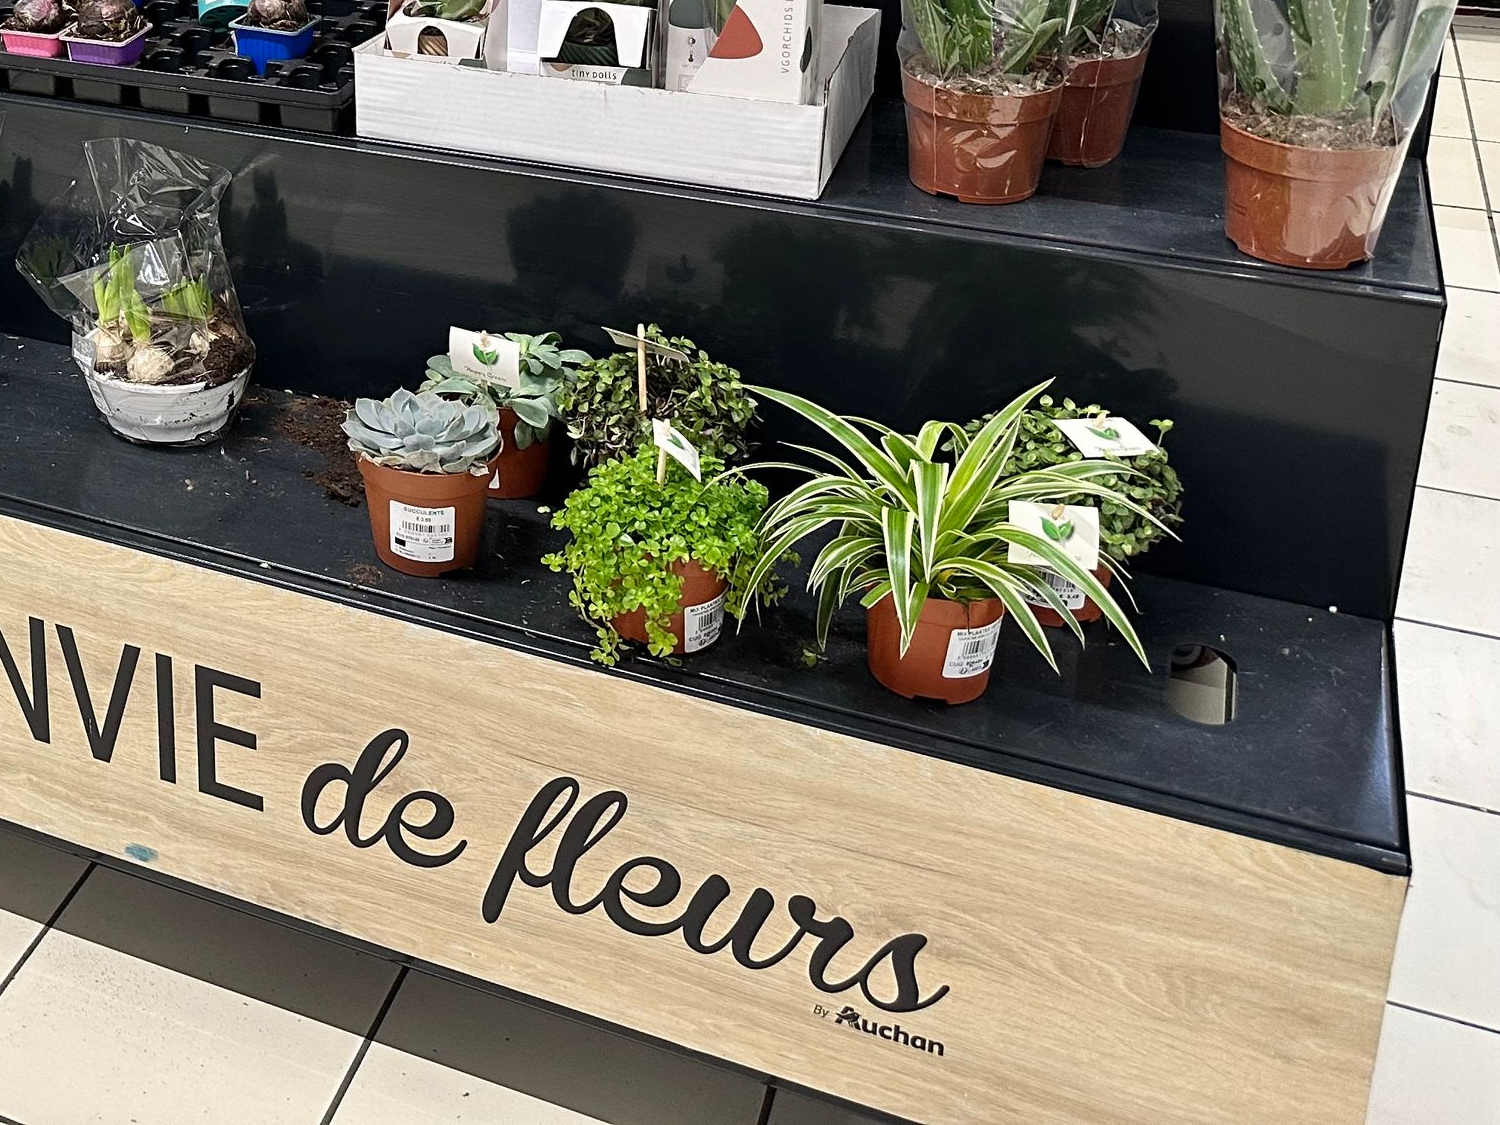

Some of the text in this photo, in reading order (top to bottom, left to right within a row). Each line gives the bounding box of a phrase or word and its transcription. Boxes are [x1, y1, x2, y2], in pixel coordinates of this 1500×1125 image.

[404, 506, 444, 515] SUCCULENTE
[300, 728, 468, 868] de
[481, 776, 951, 1013] fleurs
[813, 1004, 945, 1056] By Auchan
